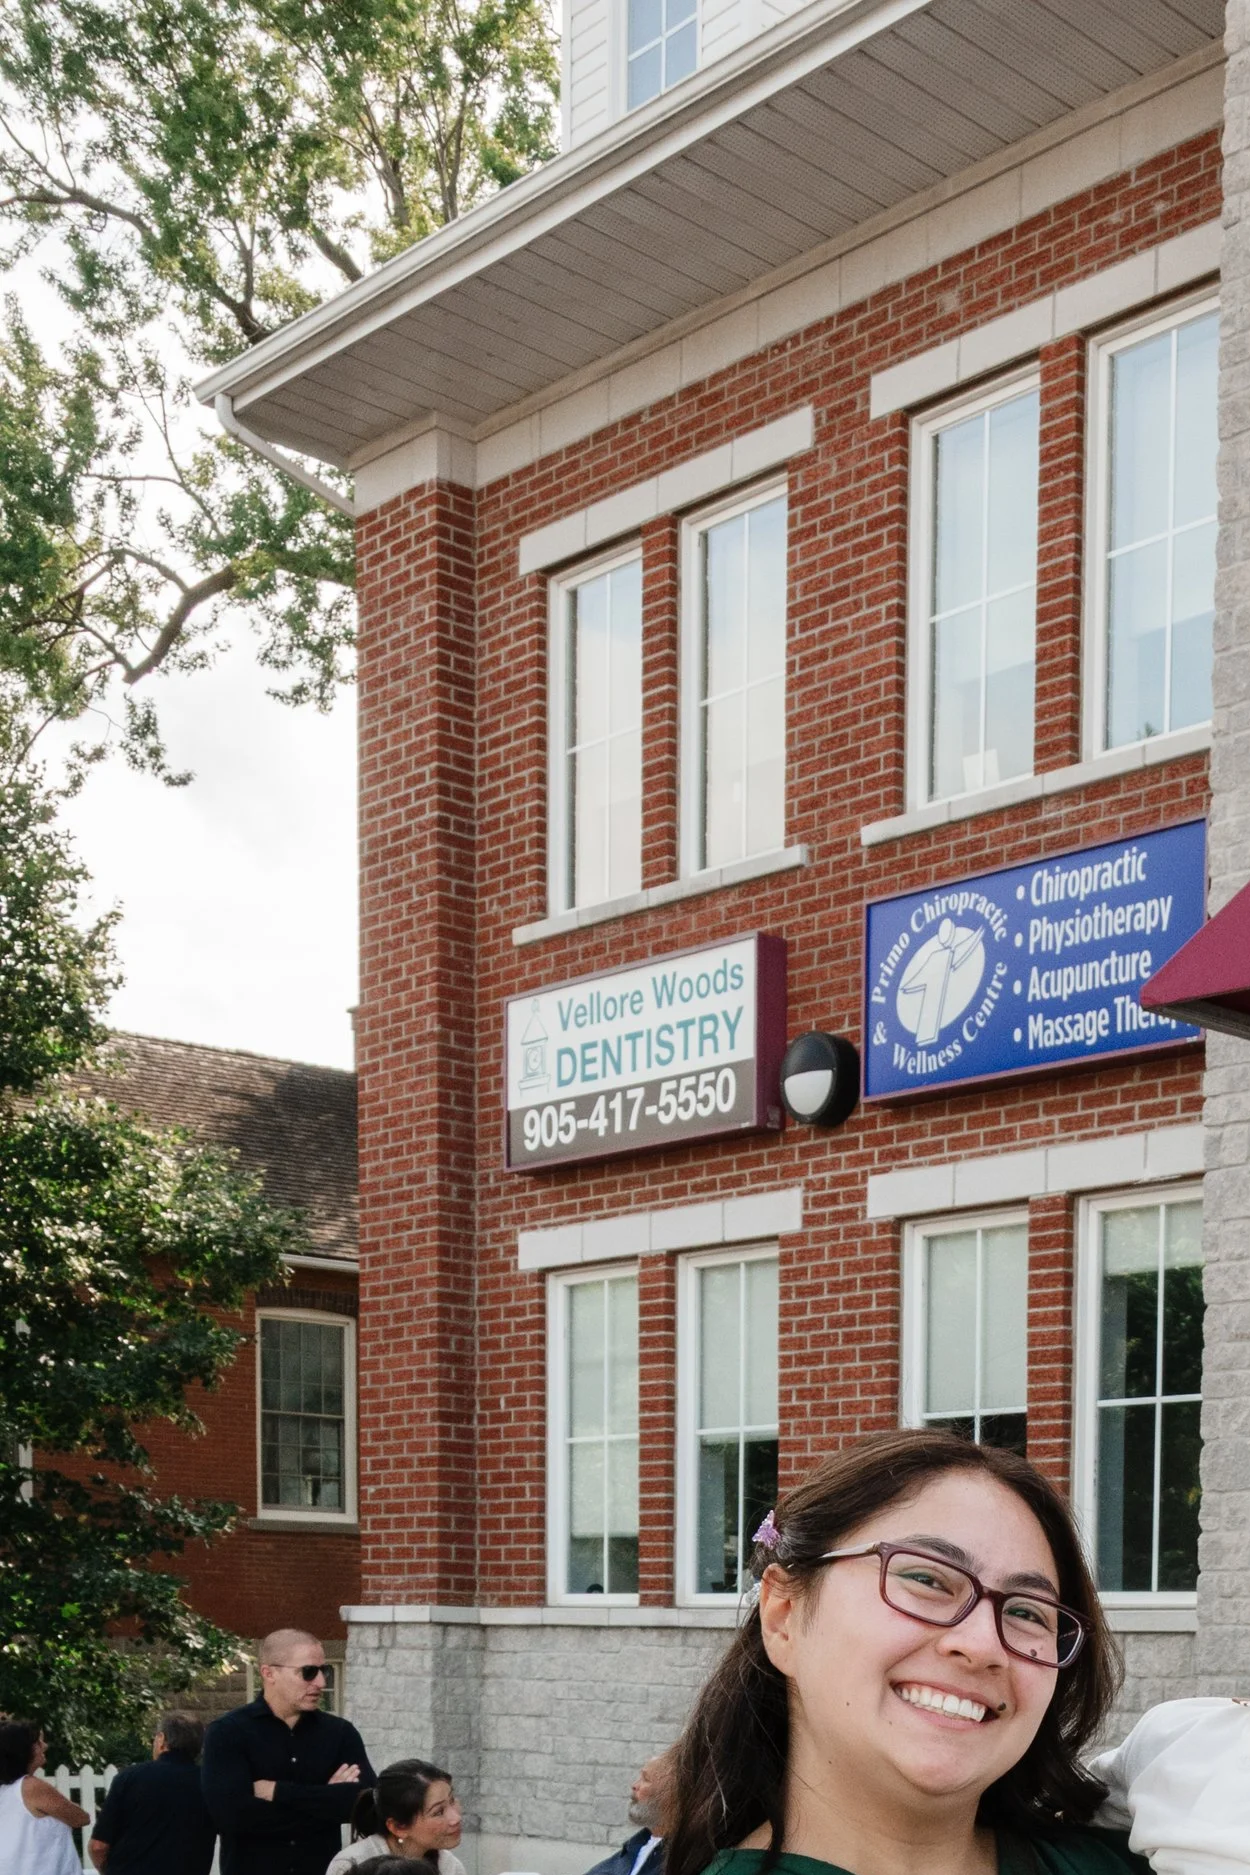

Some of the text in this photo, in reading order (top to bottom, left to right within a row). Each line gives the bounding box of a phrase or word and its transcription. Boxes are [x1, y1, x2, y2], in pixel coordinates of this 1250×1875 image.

[1030, 847, 1148, 907] Chiropractic
[872, 892, 1008, 1003] Primo Chiropractic
[1029, 895, 1173, 954] Physiotherapy
[557, 958, 744, 1032] Vellore Woods
[1027, 949, 1151, 1002] Acupuncture
[557, 1005, 744, 1088] DENTISTRY
[873, 962, 1007, 1074] & Wellness Centre
[1028, 1008, 1109, 1050] Massage
[524, 1068, 736, 1150] 905-417-5550
